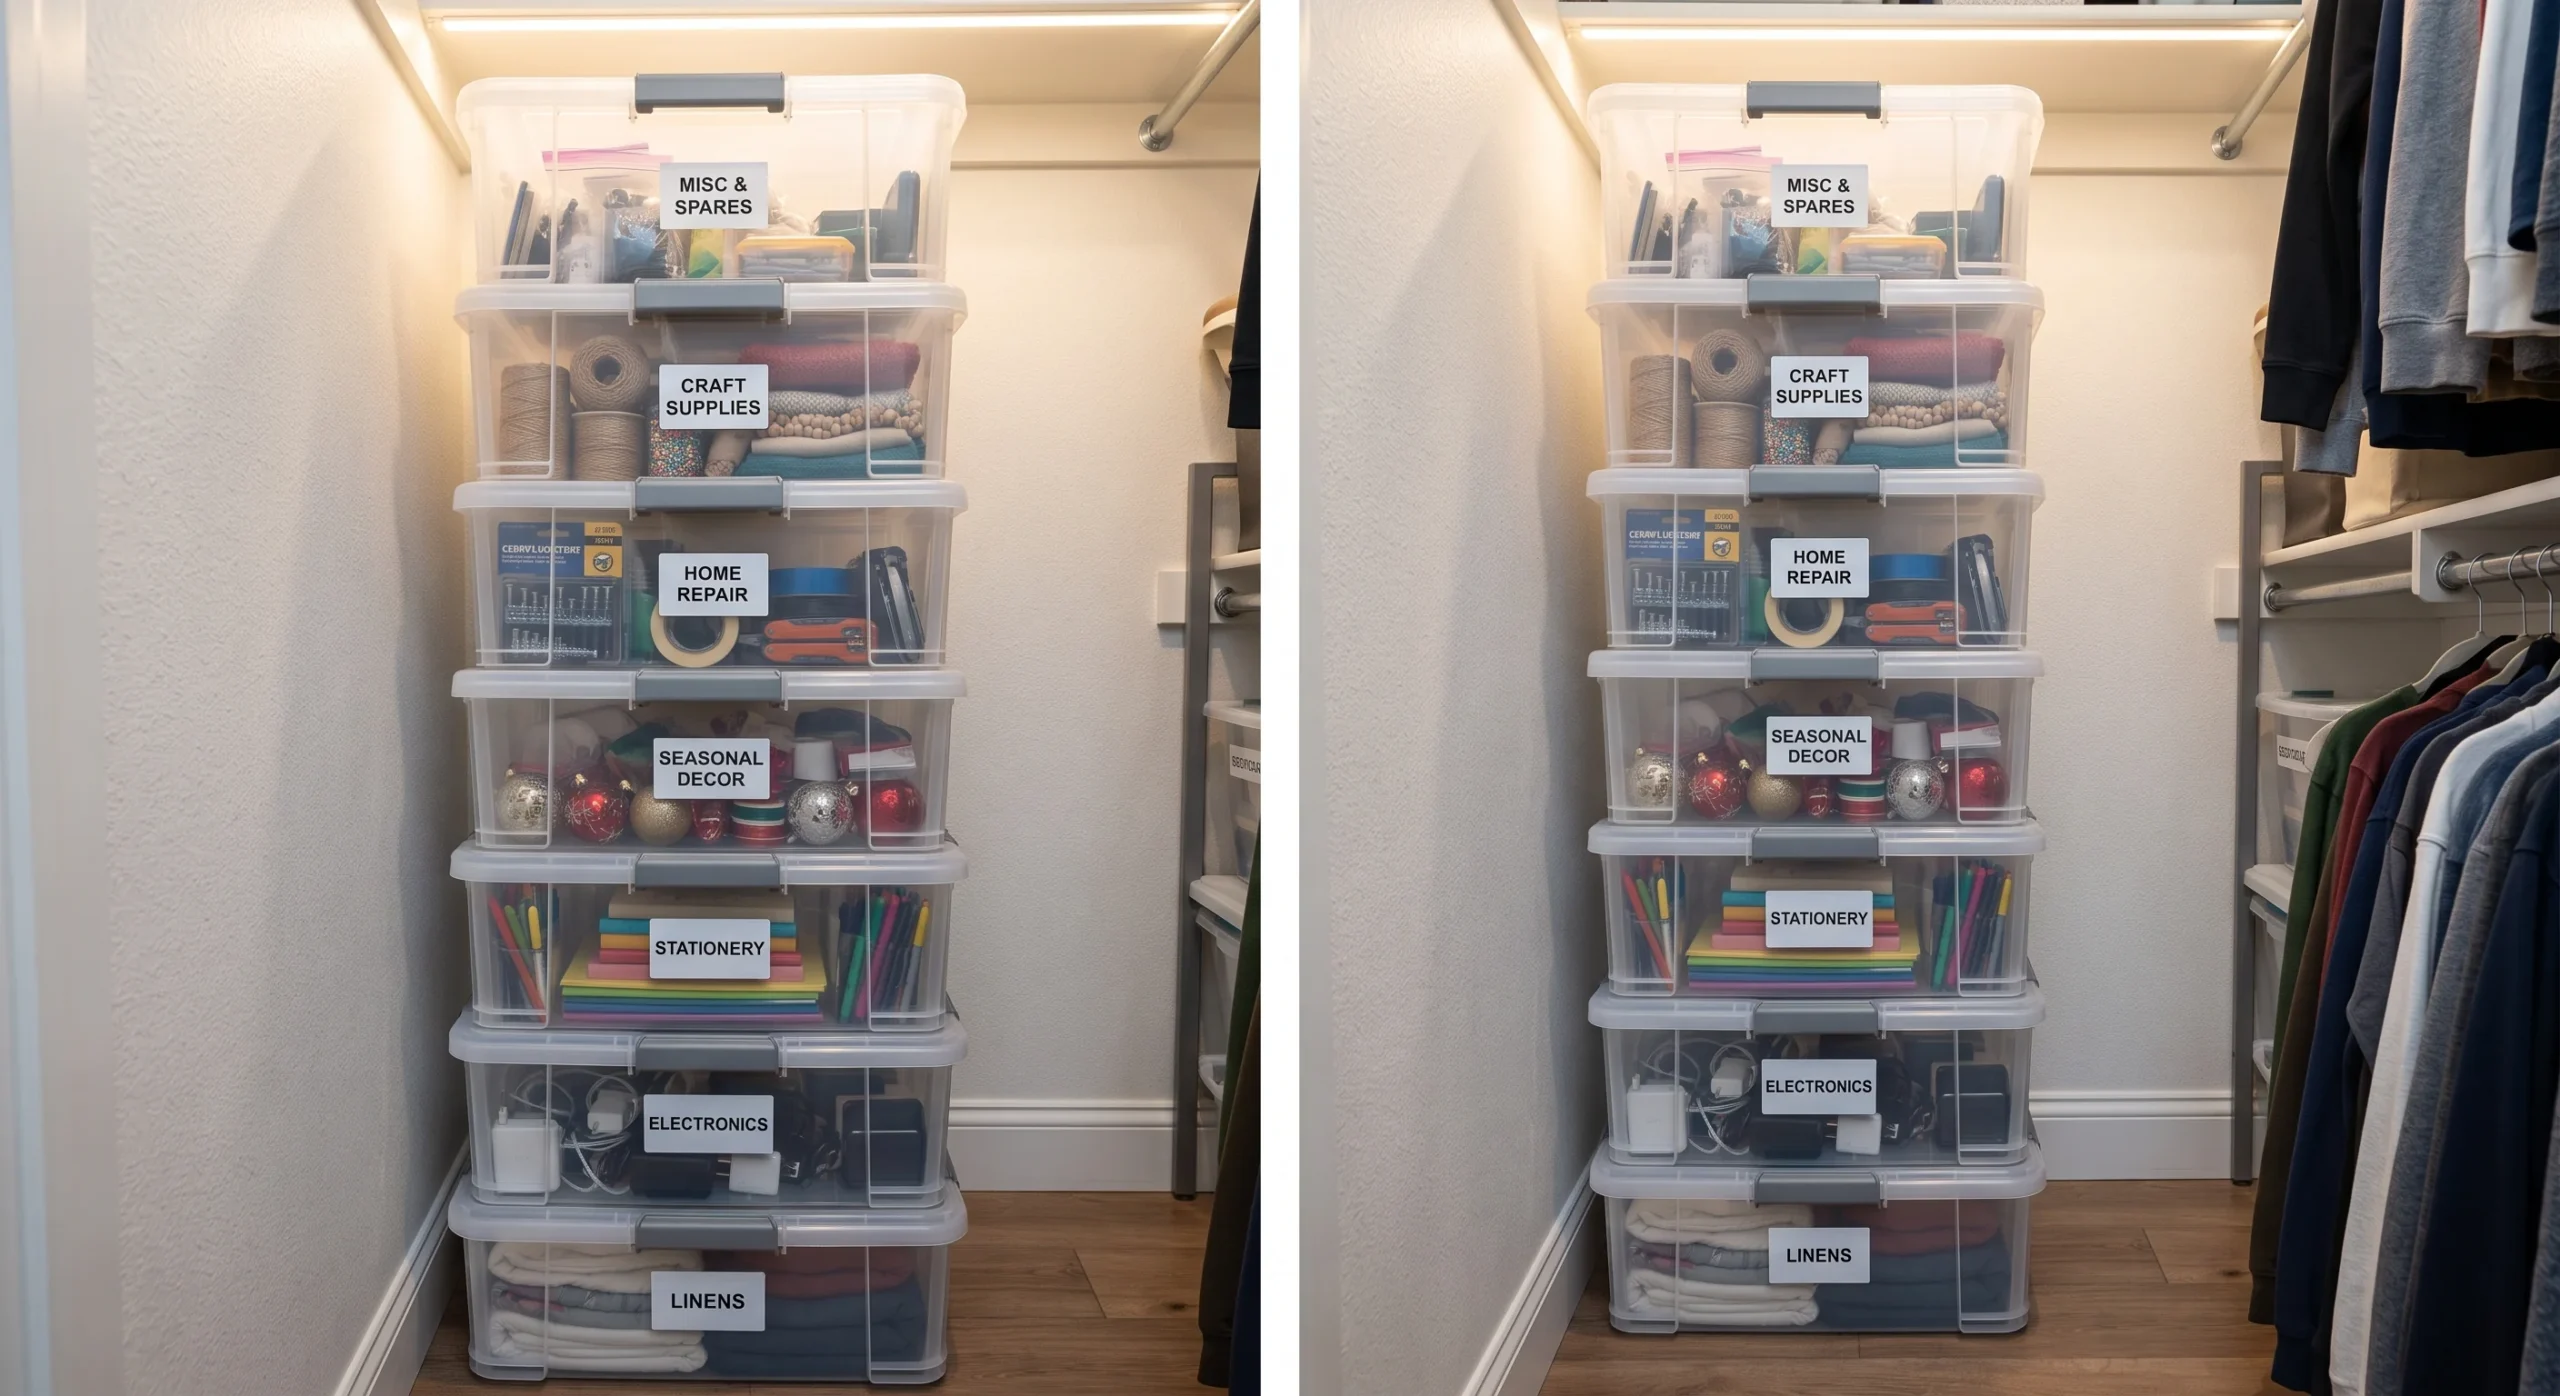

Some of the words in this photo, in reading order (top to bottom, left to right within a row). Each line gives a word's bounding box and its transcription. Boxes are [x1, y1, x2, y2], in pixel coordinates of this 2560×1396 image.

[680, 176, 728, 193] MISC
[734, 176, 748, 192] &
[1787, 178, 1832, 193] MISC
[1837, 178, 1851, 193] &
[674, 198, 753, 215] SPARES
[1783, 199, 1855, 214] SPARES
[1789, 368, 1850, 384] CRAFT
[681, 378, 747, 394] CRAFT
[1776, 389, 1863, 404] SUPPLIES
[666, 399, 761, 416] SUPPLIES
[1794, 550, 1846, 564] HOME
[684, 565, 742, 581] HOME
[1787, 570, 1852, 585] REPAIR
[677, 586, 748, 602] REPAIR
[1771, 729, 1867, 744] SEASONAL
[659, 750, 764, 766] SEASONAL
[1788, 749, 1850, 764] DECOR
[677, 771, 746, 787] DECOR
[1770, 911, 1868, 926] STATIONERY
[655, 940, 765, 956] STATIONERY
[1765, 1079, 1873, 1094] ELECTRONICS
[649, 1116, 769, 1132] ELECTRONICS
[1786, 1247, 1852, 1263] LINENS
[671, 1292, 745, 1310] LINENS
